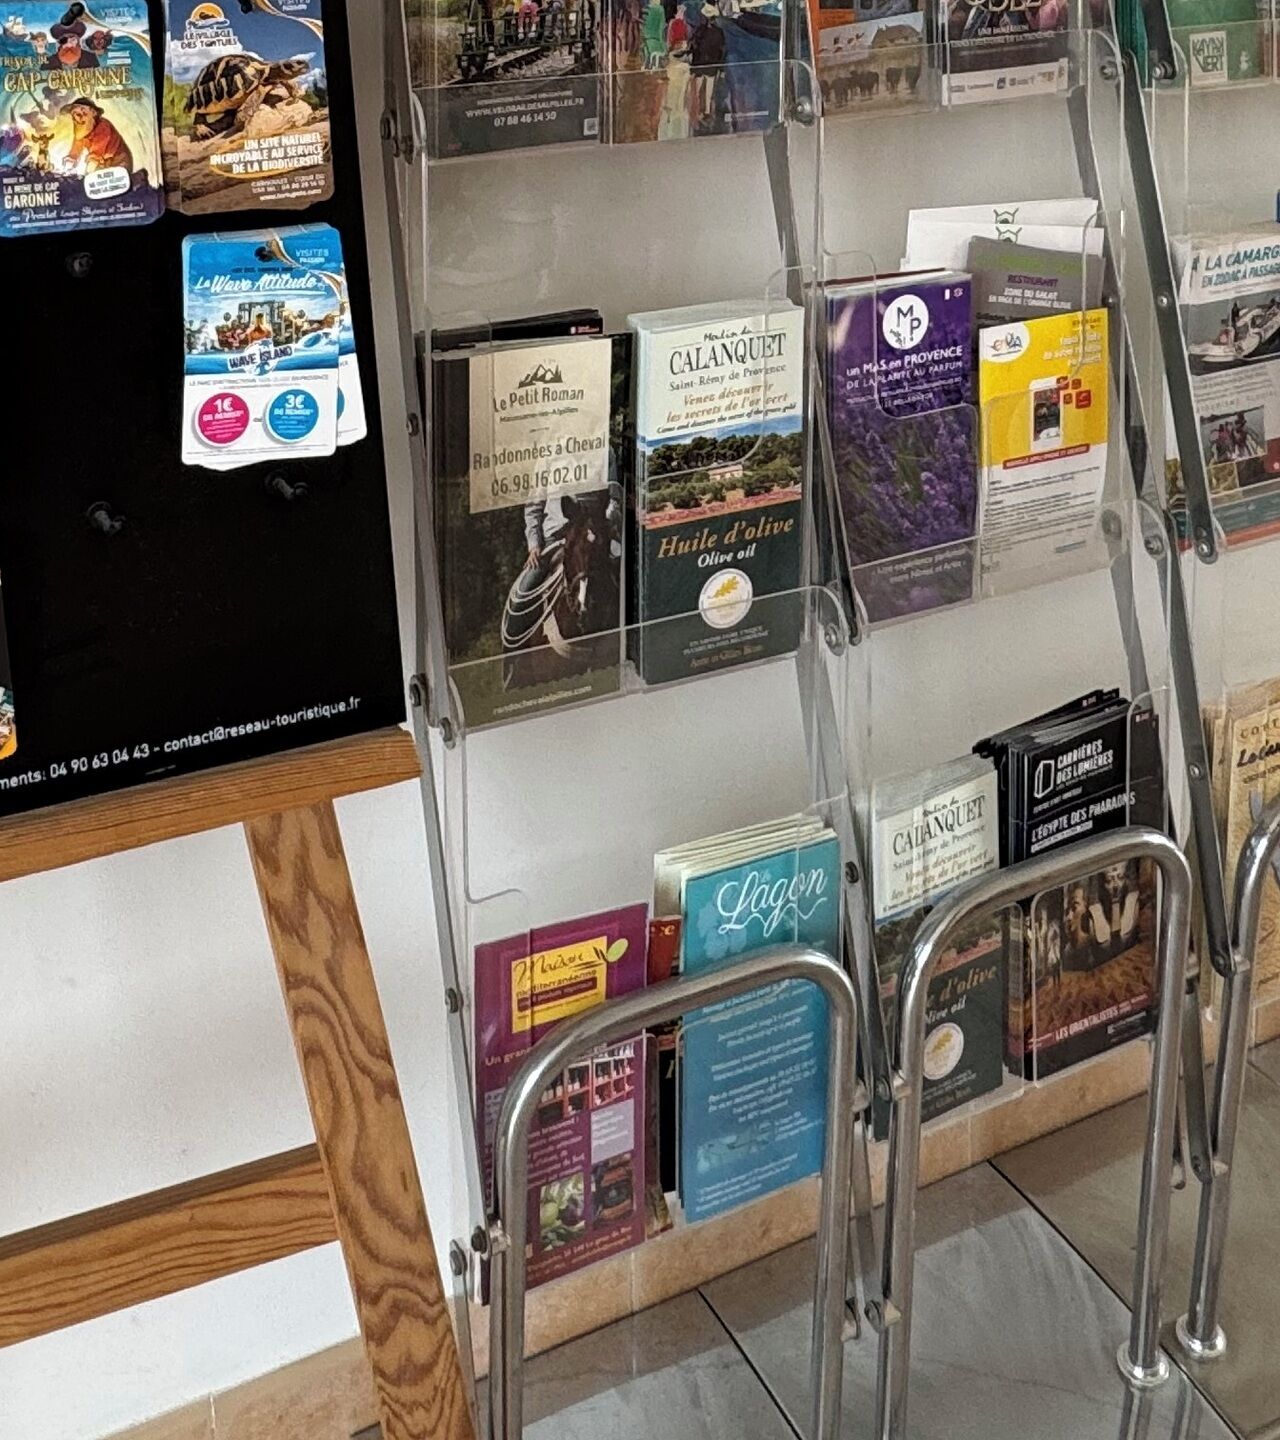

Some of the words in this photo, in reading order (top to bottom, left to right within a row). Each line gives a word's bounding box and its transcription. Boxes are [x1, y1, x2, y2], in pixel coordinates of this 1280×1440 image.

[1204, 253, 1222, 271] LA
[228, 351, 257, 371] WAVE
[258, 344, 295, 363] ISLAND
[669, 331, 788, 377] CALANQUET
[284, 393, 305, 410] 3€
[492, 395, 506, 413] Le
[507, 390, 540, 411] Petit
[541, 386, 585, 404] Roman
[471, 444, 554, 472] Randonnées
[555, 442, 563, 457] à
[565, 432, 608, 455] Cheval
[490, 463, 590, 497] 06.98.16.02.01
[656, 526, 719, 560] Huile
[723, 515, 796, 546] d'olive
[696, 548, 734, 569] Olive
[736, 543, 757, 561] oil
[48, 759, 69, 780] 04
[69, 755, 91, 774] 90
[92, 750, 112, 770] 63
[112, 746, 133, 766] 04
[132, 742, 151, 761] 43
[161, 694, 363, 755] contact@reseau-touristique.fr
[1056, 738, 1104, 768] CARRIÈRES
[1056, 765, 1073, 784] DES
[1073, 749, 1115, 778] LUMIÈRES
[891, 793, 987, 857] CALANQUET
[1031, 813, 1069, 843] L'ÉGYPTE
[1069, 807, 1087, 827] DES
[1087, 790, 1137, 820] PHARAONS
[716, 865, 829, 937] Lagon
[939, 965, 998, 1002] d'olive
